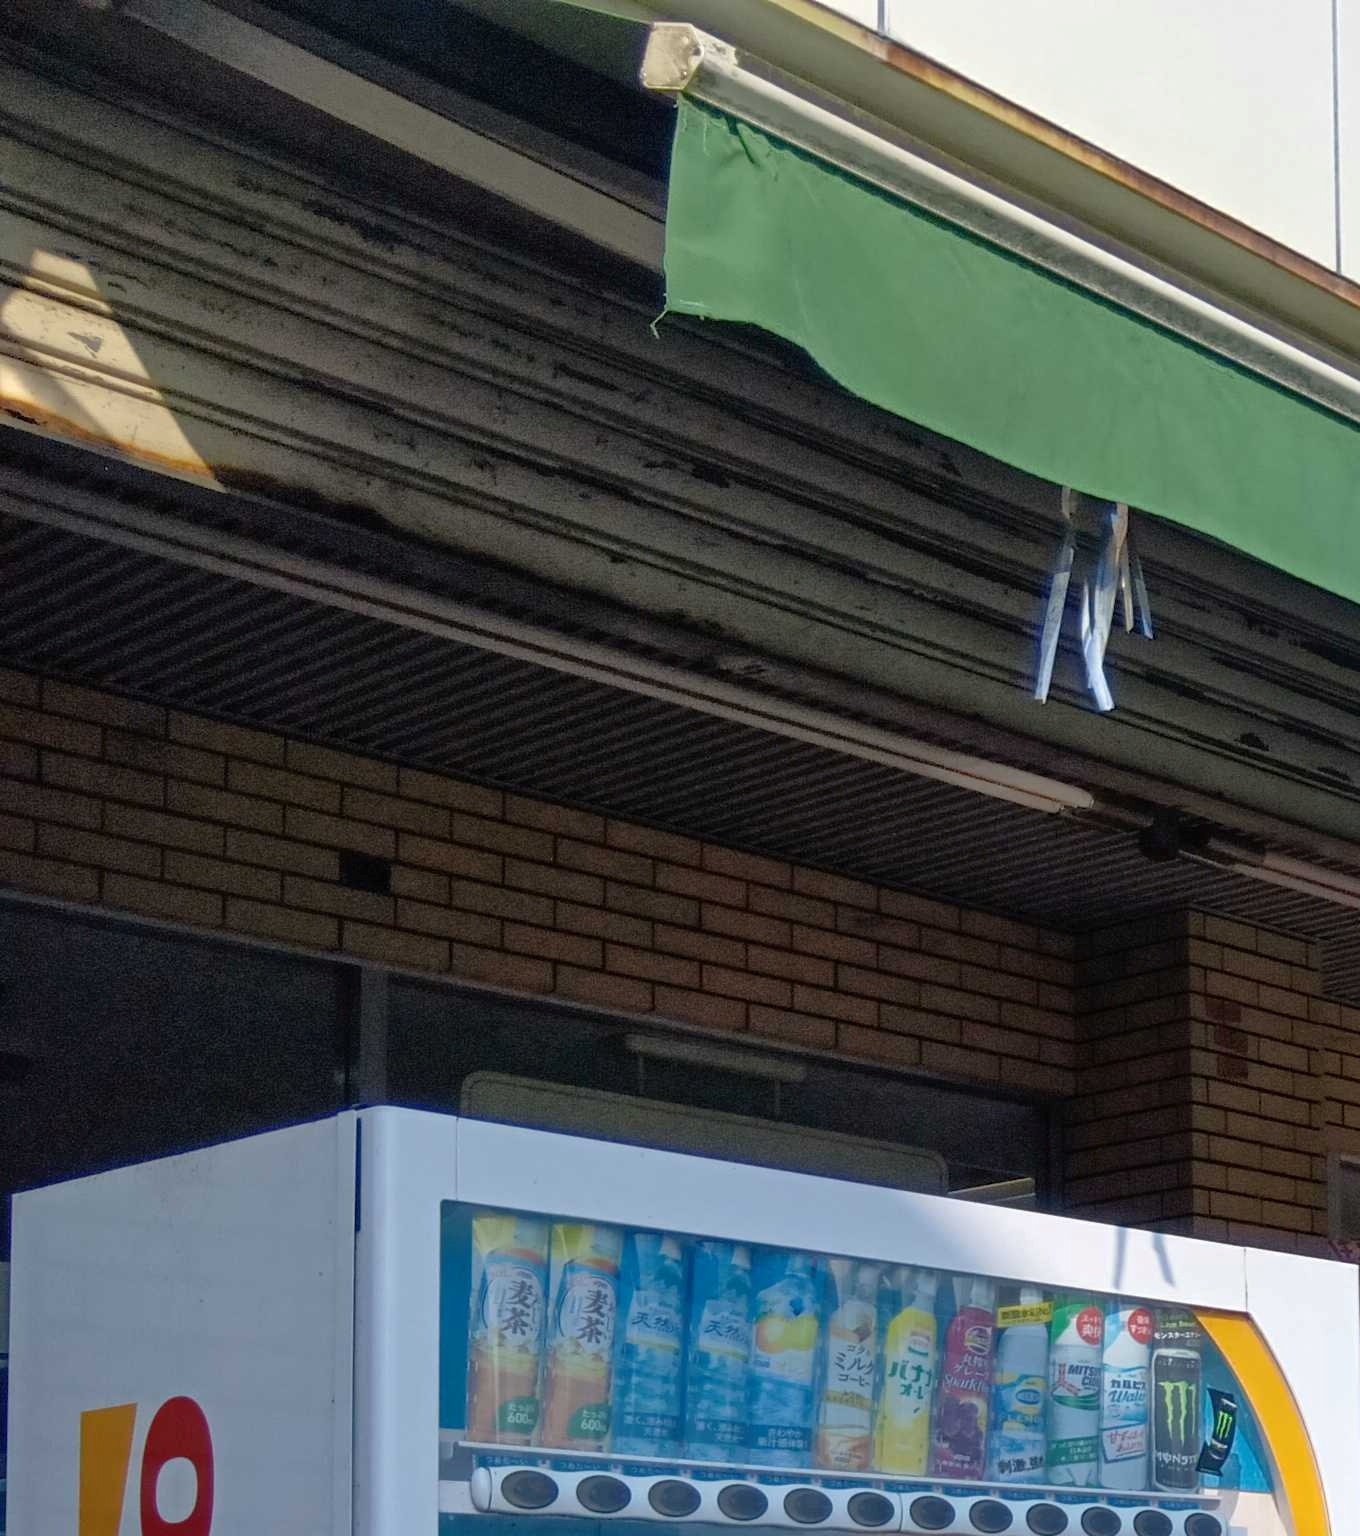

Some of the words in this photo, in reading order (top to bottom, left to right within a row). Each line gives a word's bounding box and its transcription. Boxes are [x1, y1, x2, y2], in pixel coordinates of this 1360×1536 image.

[500, 1279, 534, 1336] 麦茶
[576, 1288, 610, 1344] 麦茶
[632, 1312, 675, 1333] 天然
[704, 1320, 747, 1342] 天然
